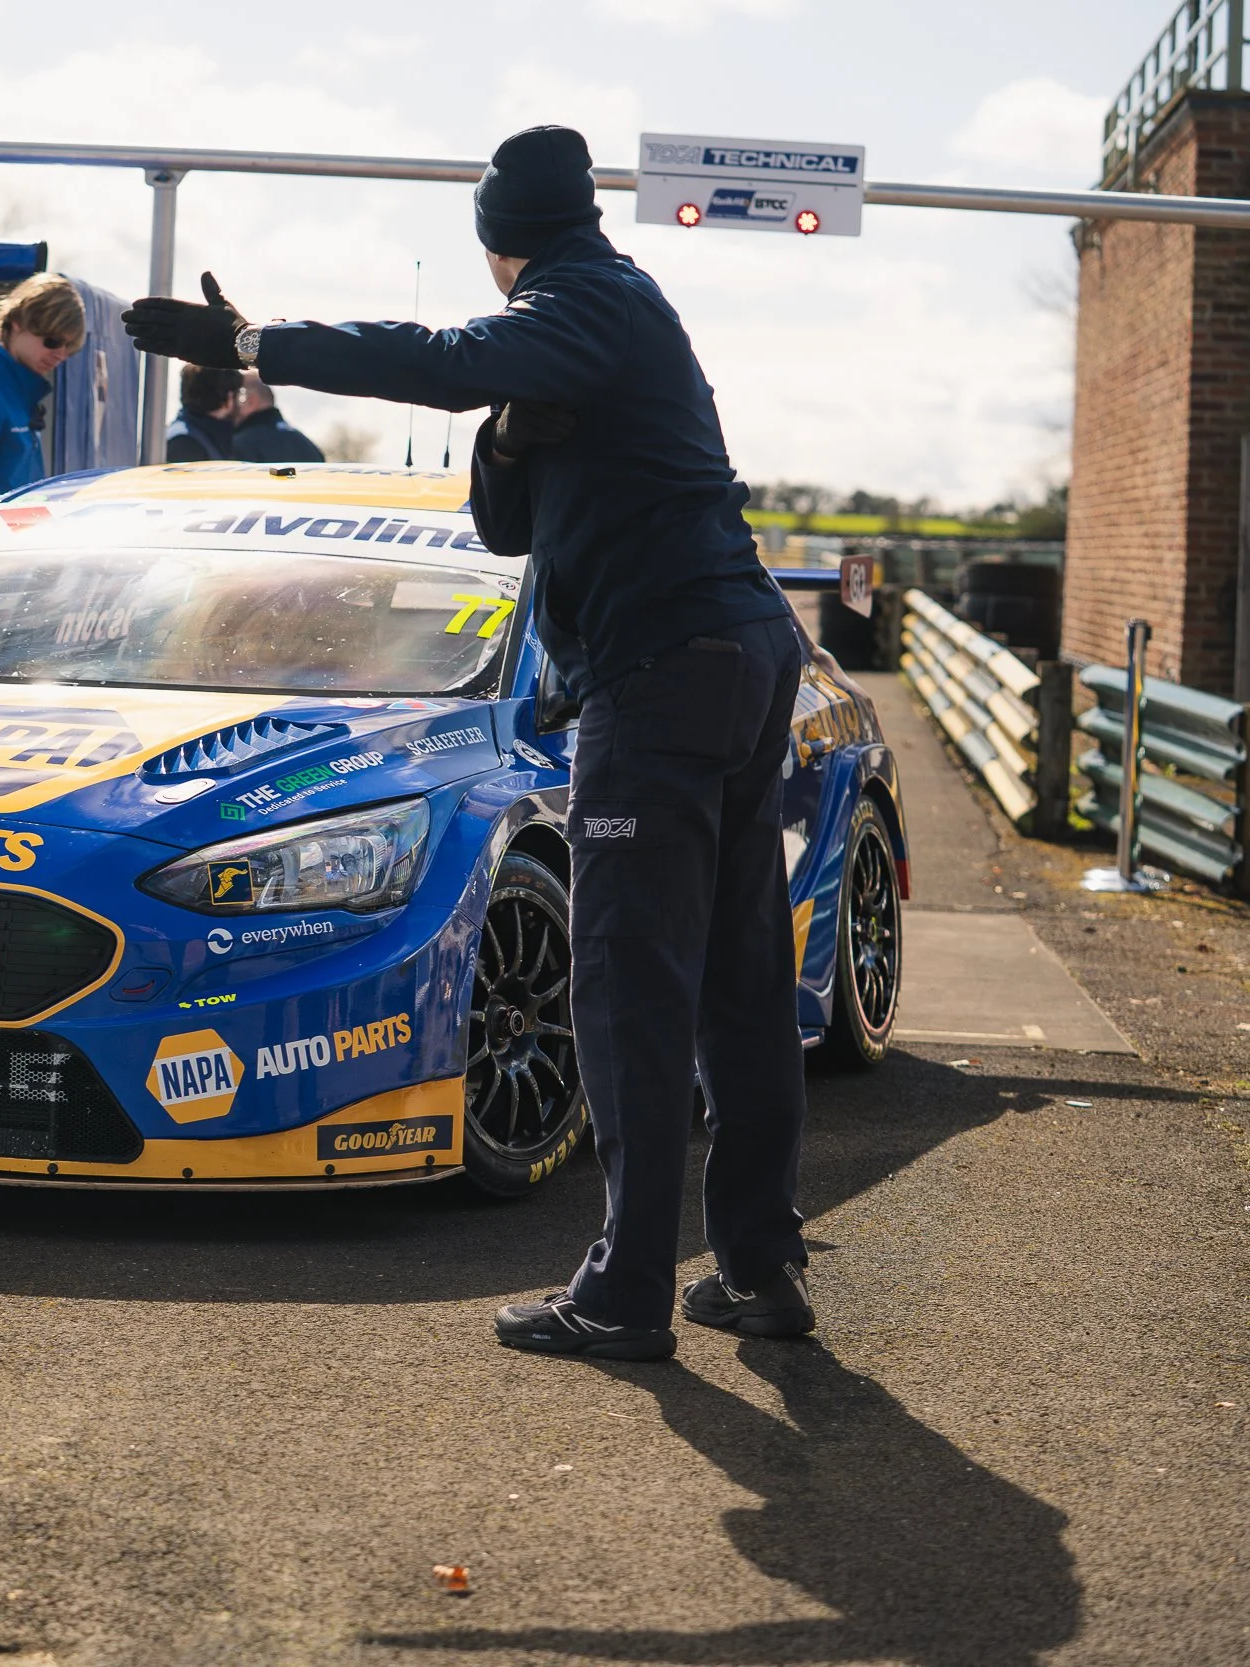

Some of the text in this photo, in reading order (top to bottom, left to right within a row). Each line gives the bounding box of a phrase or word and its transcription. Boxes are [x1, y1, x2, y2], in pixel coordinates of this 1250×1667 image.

[709, 149, 850, 172] TECHNICAL
[755, 198, 788, 209] BTCC
[146, 509, 492, 554] alvoline
[444, 593, 516, 639] 77
[405, 726, 488, 756] SCHAEFFLER
[236, 750, 385, 808] THE GREEN GROUP
[258, 791, 304, 816] Dedicated
[314, 777, 348, 795] Service
[583, 817, 637, 838] TOCA
[241, 919, 333, 944] everywhen
[194, 994, 237, 1007] TOW
[161, 1012, 412, 1100] NAPA AUTO PARTS
[334, 1123, 437, 1150] GOODYEAR
